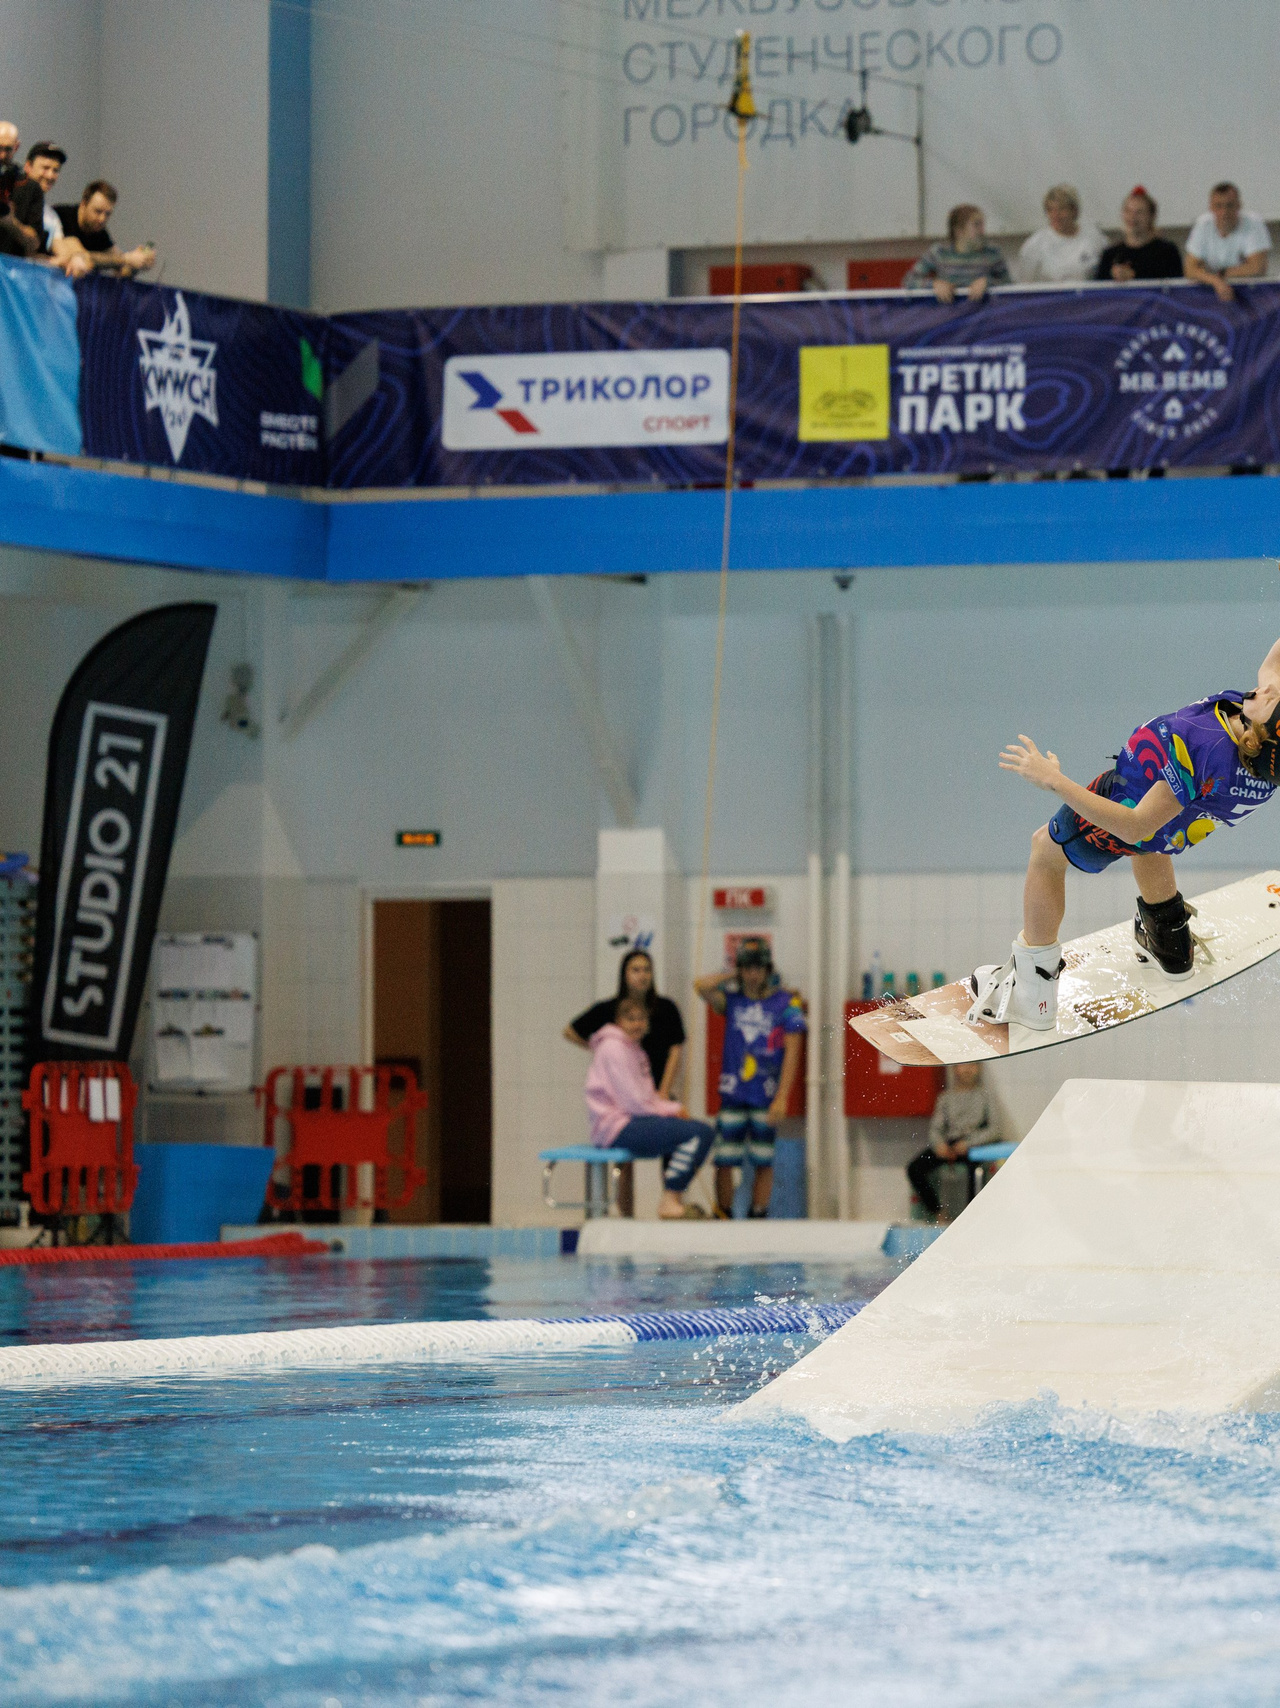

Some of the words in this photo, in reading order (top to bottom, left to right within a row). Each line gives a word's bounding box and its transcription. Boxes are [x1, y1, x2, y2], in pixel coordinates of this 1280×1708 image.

[517, 372, 711, 403] ТРИКОЛОР
[898, 355, 1027, 393] ТРЕТИЙ
[643, 414, 711, 434] СПОРТ
[898, 393, 1027, 434] ПАРК
[95, 732, 143, 795] 21
[62, 808, 131, 1018] STUDIO
